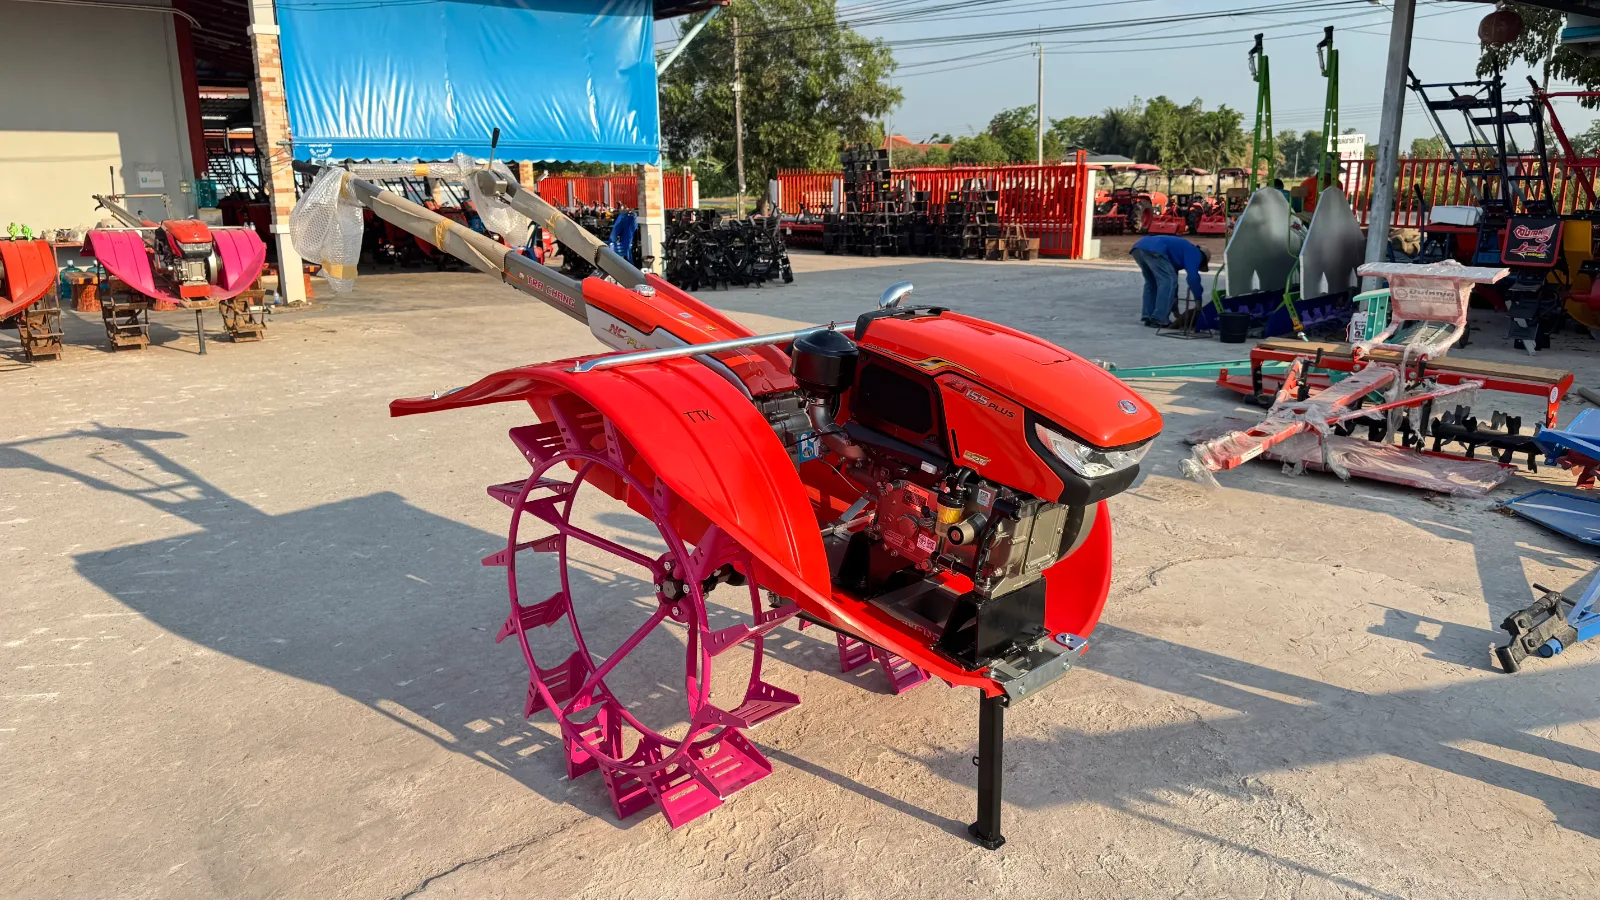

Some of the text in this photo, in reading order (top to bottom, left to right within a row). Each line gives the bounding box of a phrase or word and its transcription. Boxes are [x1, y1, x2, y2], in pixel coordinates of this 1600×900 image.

[527, 275, 575, 307] TRA CHANG
[609, 323, 627, 339] NC
[682, 409, 717, 423] TTK
[988, 402, 1015, 418] PLUS
